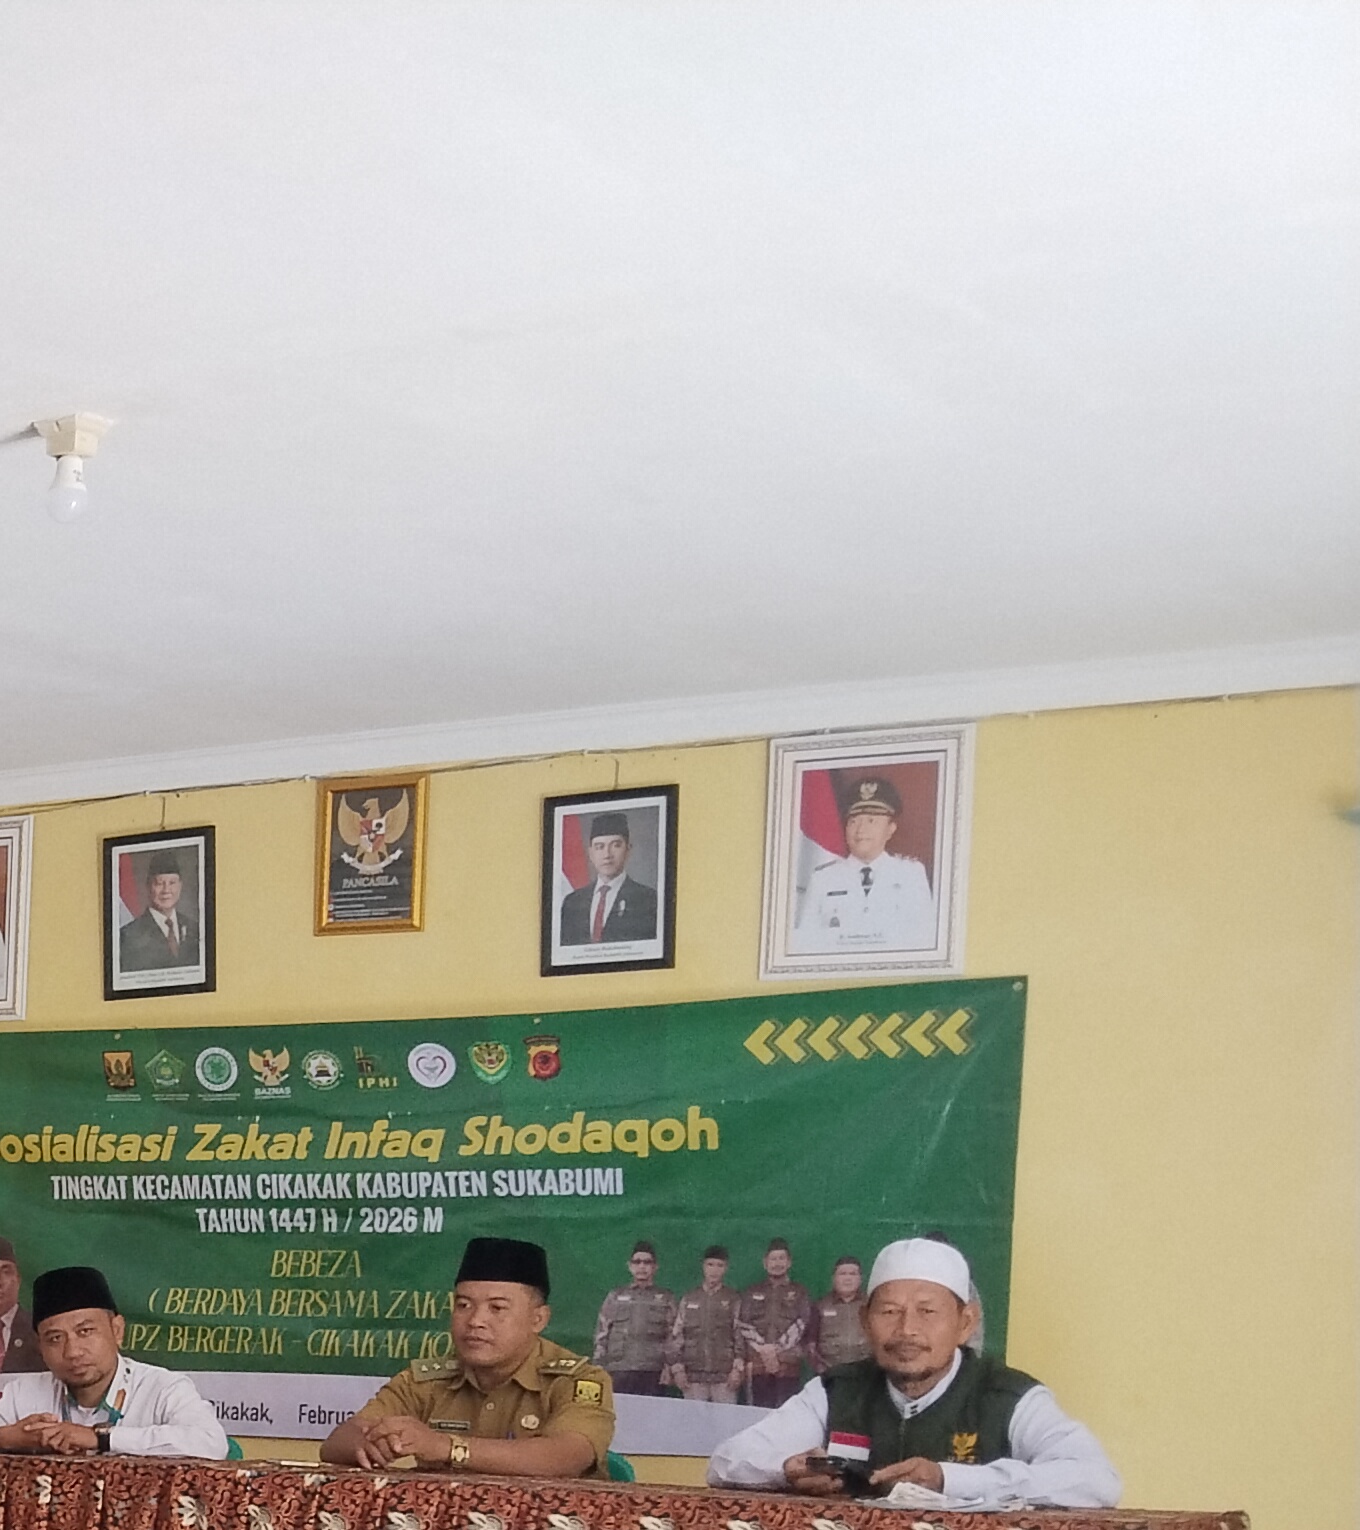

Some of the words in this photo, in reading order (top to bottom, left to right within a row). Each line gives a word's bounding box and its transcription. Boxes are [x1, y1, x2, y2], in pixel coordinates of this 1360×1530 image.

[342, 875, 399, 889] PANCASILA
[185, 1123, 314, 1161] Zakat
[324, 1119, 446, 1163] Infaq
[457, 1105, 720, 1159] Shodaqoh
[50, 1175, 129, 1201] TINGKAT
[132, 1174, 252, 1201] KECAMATAN
[256, 1172, 352, 1200] CIKAKAK
[356, 1170, 487, 1198] KABUPATEN
[492, 1168, 624, 1196] SUKABUMI
[195, 1207, 265, 1233] TAHUN
[268, 1207, 317, 1233] 1447
[321, 1207, 337, 1232] H
[343, 1208, 353, 1232] /
[359, 1206, 418, 1233] 2026
[423, 1207, 444, 1232] M
[270, 1249, 363, 1279] BEBEZA
[163, 1287, 263, 1316] BERDAYA
[268, 1289, 378, 1319] BERSAMA
[385, 1290, 455, 1320] ZAKA
[167, 1325, 286, 1356] BERGERAK
[307, 1328, 417, 1359] CIKAKAK
[419, 1331, 453, 1359] KO
[212, 1400, 273, 1426] ikakak,
